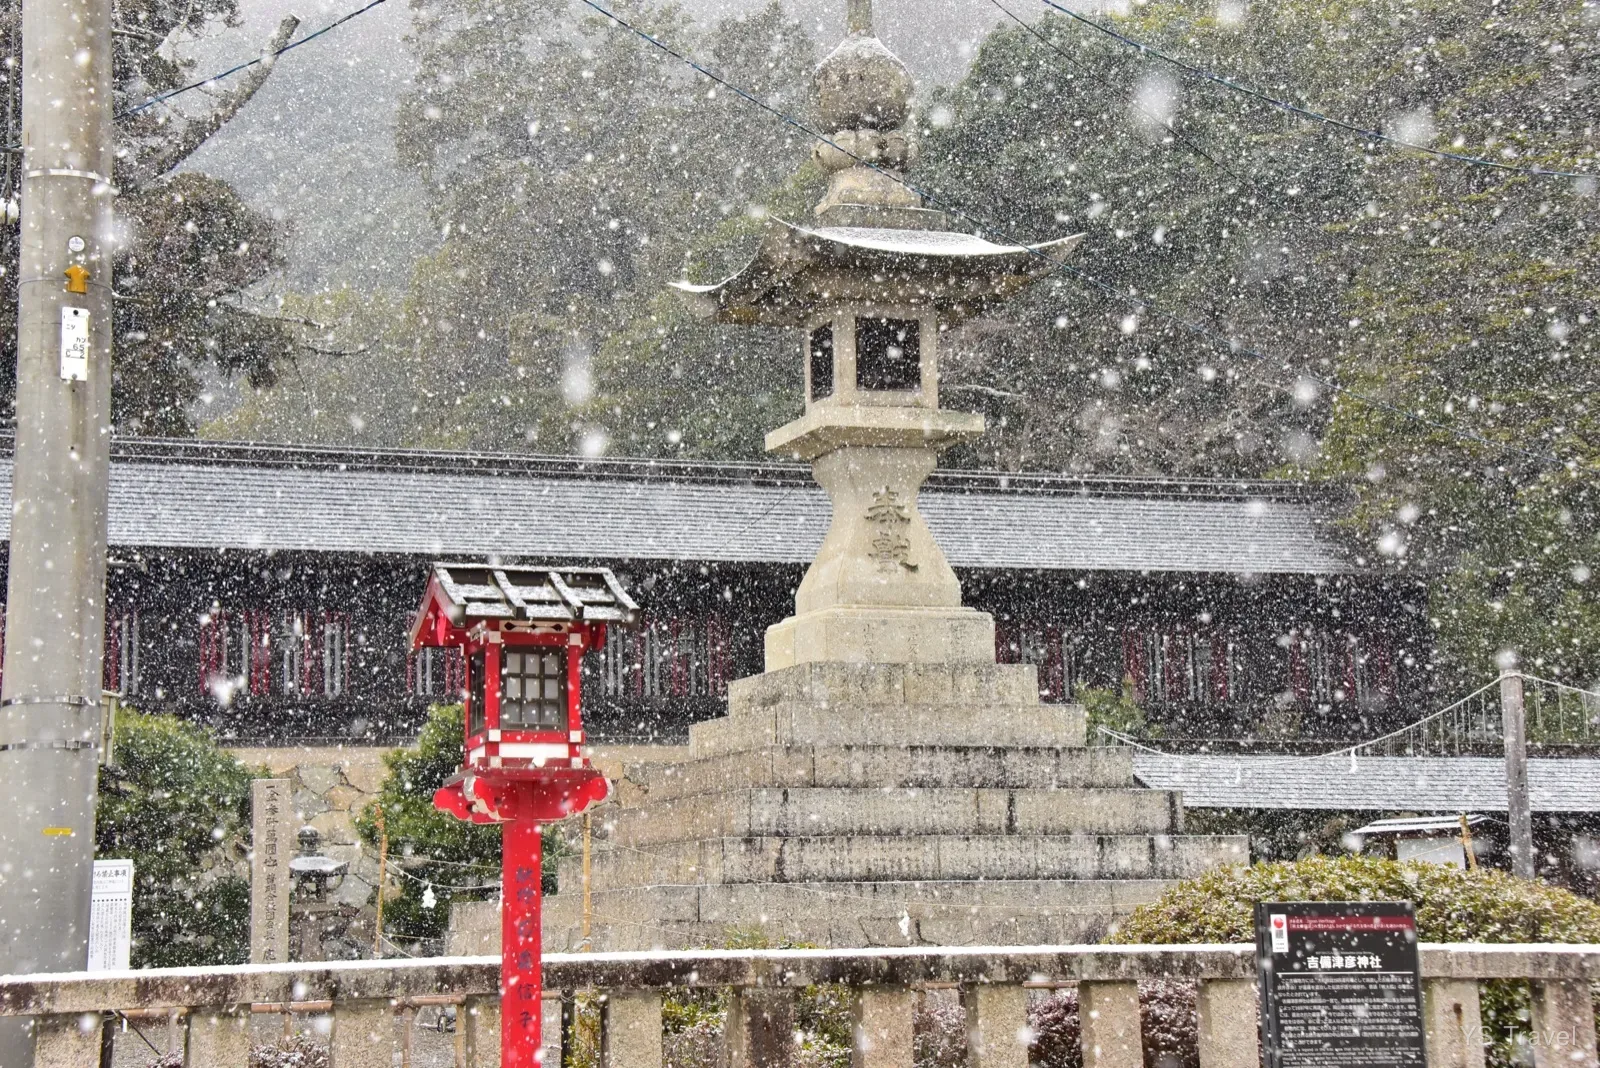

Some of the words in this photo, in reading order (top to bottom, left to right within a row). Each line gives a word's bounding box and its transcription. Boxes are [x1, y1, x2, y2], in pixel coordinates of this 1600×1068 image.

[1306, 955, 1383, 969] 吉備津彦神社
